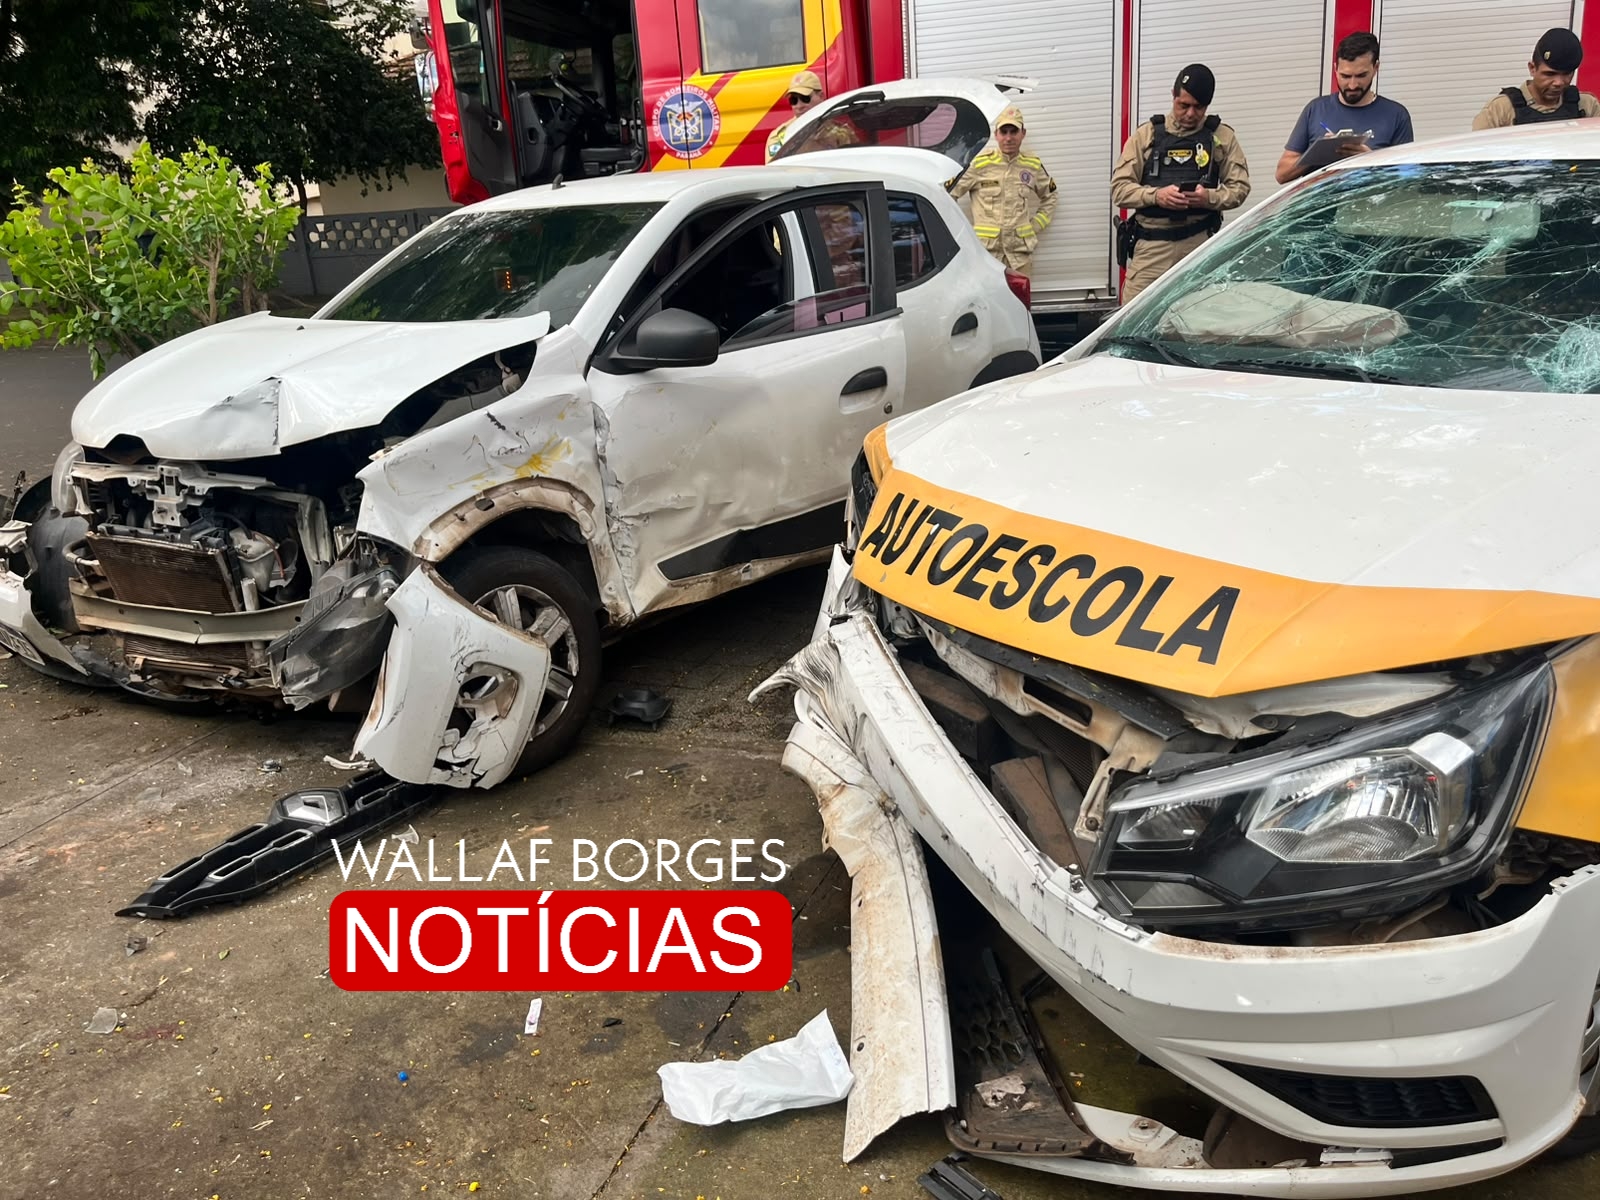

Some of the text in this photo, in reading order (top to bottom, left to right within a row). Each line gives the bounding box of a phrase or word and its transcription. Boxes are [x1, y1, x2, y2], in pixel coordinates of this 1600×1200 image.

[652, 86, 720, 137] CORPO DE BOMBEIROS MILITAR
[860, 492, 1240, 665] AUTOESCOLA
